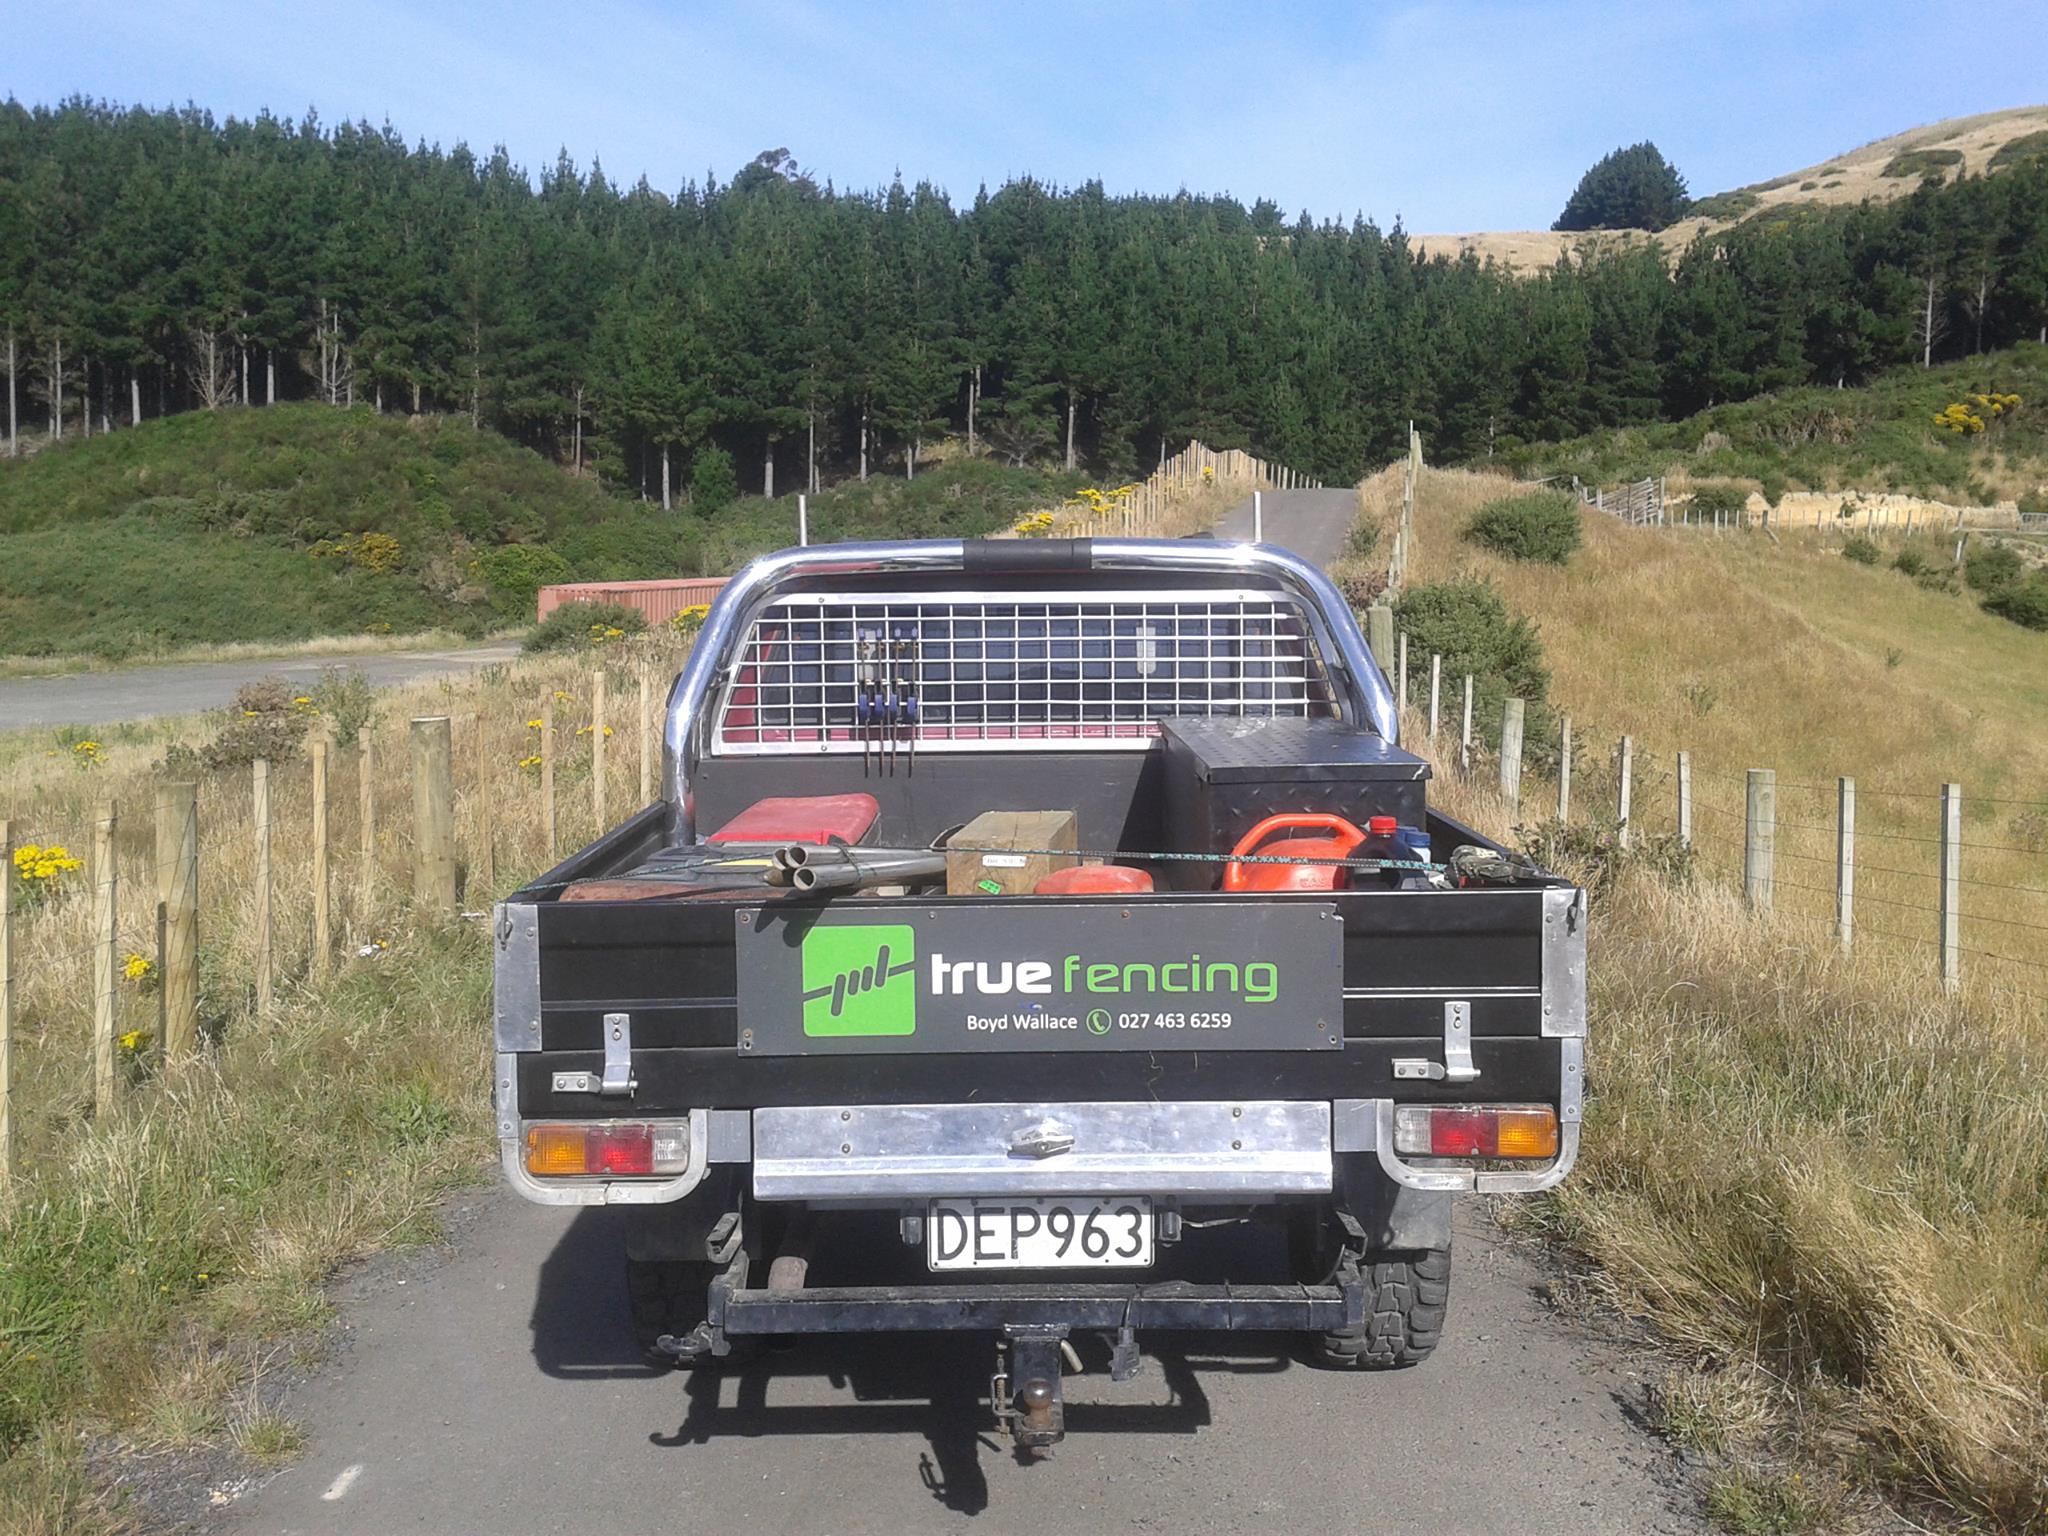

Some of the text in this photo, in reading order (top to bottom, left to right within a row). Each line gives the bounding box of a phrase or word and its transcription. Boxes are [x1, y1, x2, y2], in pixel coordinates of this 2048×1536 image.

[931, 953, 1278, 1002] true fencing
[967, 1013, 1232, 1033] Boyd Wallace 027 463 6259
[936, 1205, 1142, 1261] DEP963
